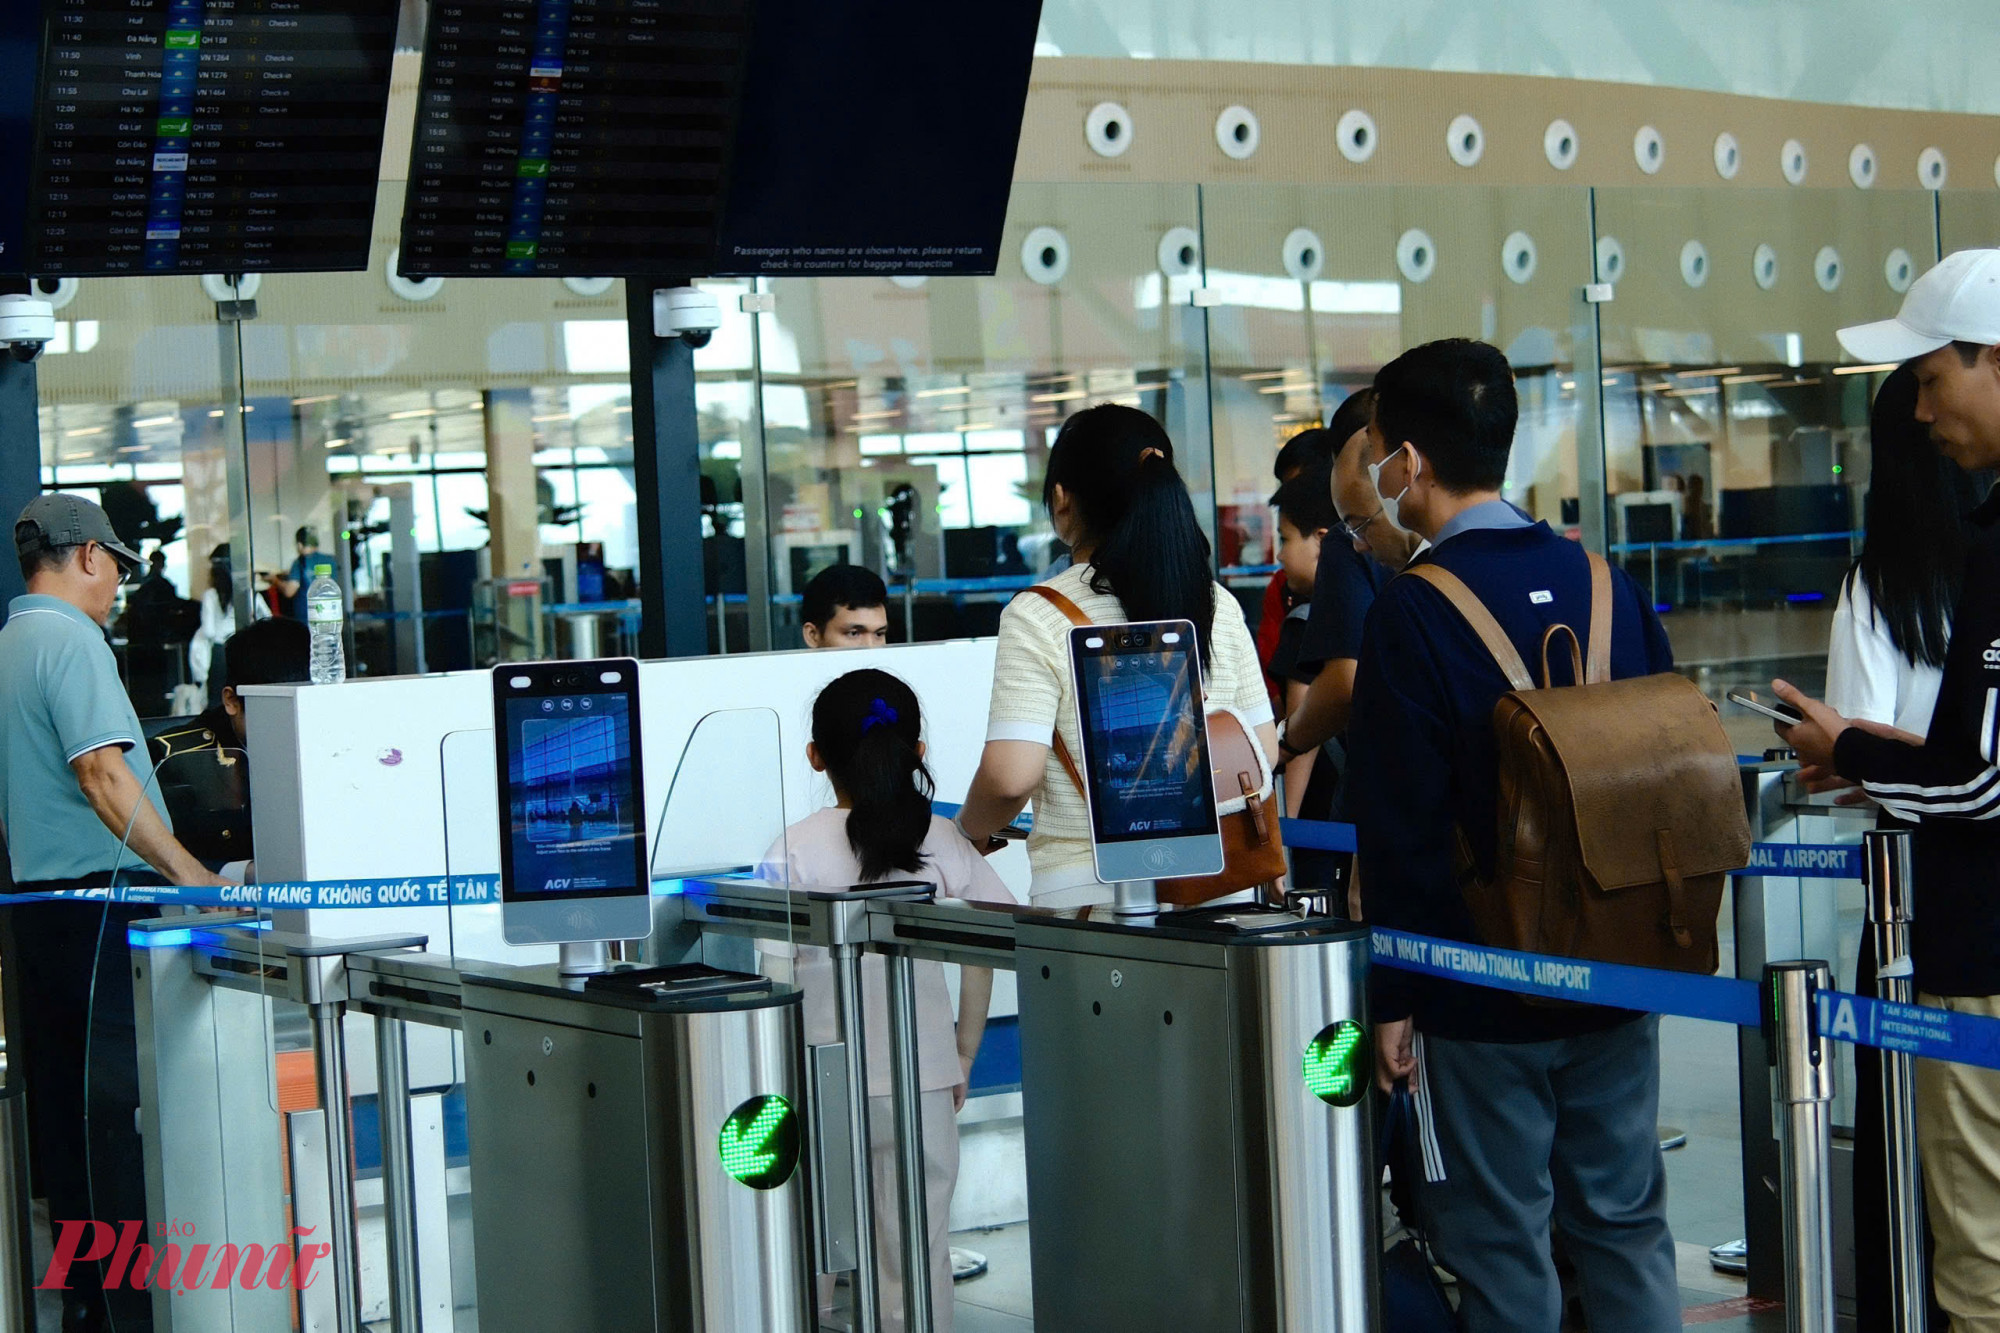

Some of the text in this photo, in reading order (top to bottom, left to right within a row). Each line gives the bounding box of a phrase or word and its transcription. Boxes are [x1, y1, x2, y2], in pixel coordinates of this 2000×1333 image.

[64, 16, 83, 24] 11:30
[125, 52, 142, 60] Vinh
[265, 54, 294, 62] Check-in
[124, 70, 146, 78] Thanh
[122, 88, 136, 96] Chu
[261, 89, 290, 97] Check-in
[53, 140, 73, 148] 12:10
[733, 246, 790, 256] Passengers
[793, 246, 812, 255] who
[814, 247, 844, 255] names
[847, 247, 863, 255] are
[866, 246, 895, 255] shown
[922, 246, 953, 256] please
[954, 246, 982, 255] return
[760, 260, 953, 270] check-in counters for baggage inspection
[1129, 821, 1151, 831] ACV
[1783, 850, 1848, 868] AIRPORT
[544, 879, 571, 889] ACV
[318, 884, 372, 905] KHÔNG
[378, 879, 420, 903] QUỐC
[456, 878, 487, 900] TÂN
[1372, 932, 1591, 990] SON NHAT INTERNATIONAL AIRPORT
[1882, 1004, 1900, 1016] TAN
[1881, 1020, 1952, 1042] INTERNATIONAL
